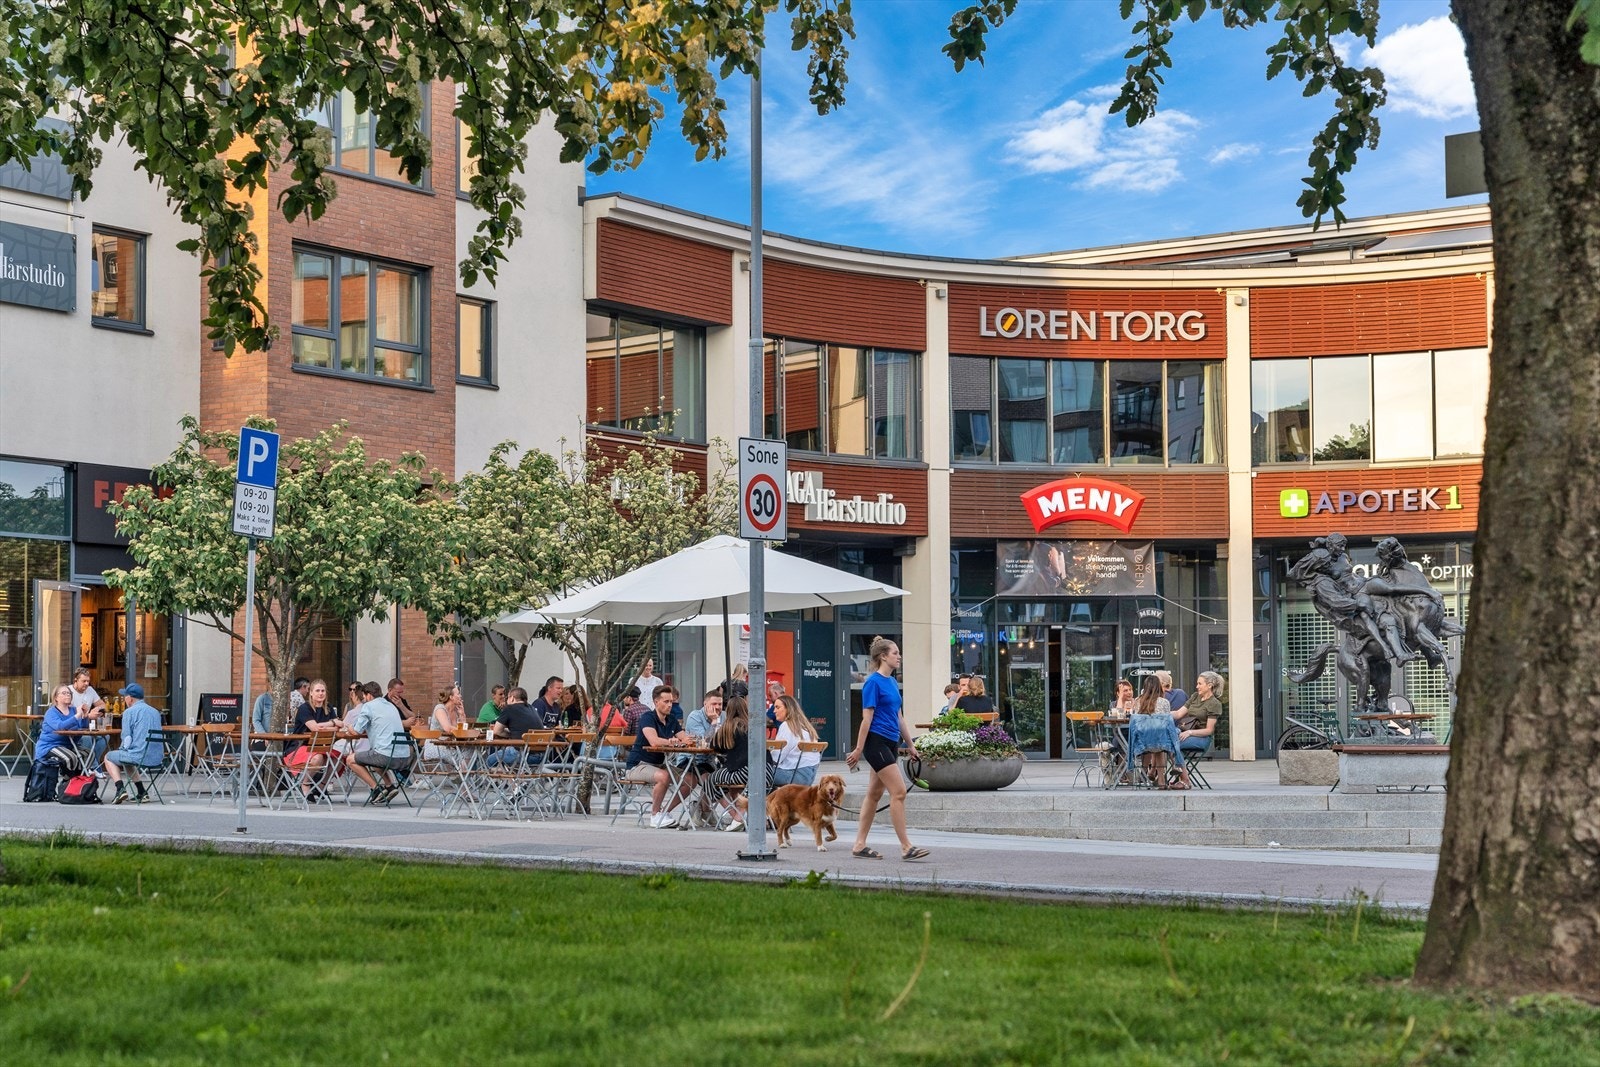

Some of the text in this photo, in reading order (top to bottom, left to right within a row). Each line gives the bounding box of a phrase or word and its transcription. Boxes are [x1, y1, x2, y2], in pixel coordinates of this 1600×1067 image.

[1103, 310, 1206, 342] TORG
[247, 436, 269, 477] P
[747, 445, 779, 465] Sone
[243, 487, 268, 501] 09-20
[239, 501, 270, 515] (09-20)
[752, 488, 776, 518] 30
[815, 488, 907, 525] Hårstudio
[1037, 488, 1134, 518] MENY
[236, 513, 250, 521] Maks
[257, 516, 271, 525] timer
[240, 523, 267, 534] mot avgift
[1087, 555, 1125, 563] Velkommen
[1102, 563, 1127, 572] hyggelig
[1139, 609, 1162, 618] MENY
[1140, 647, 1161, 656] norli
[804, 668, 832, 678] muligheter
[210, 712, 228, 722] FRYD
